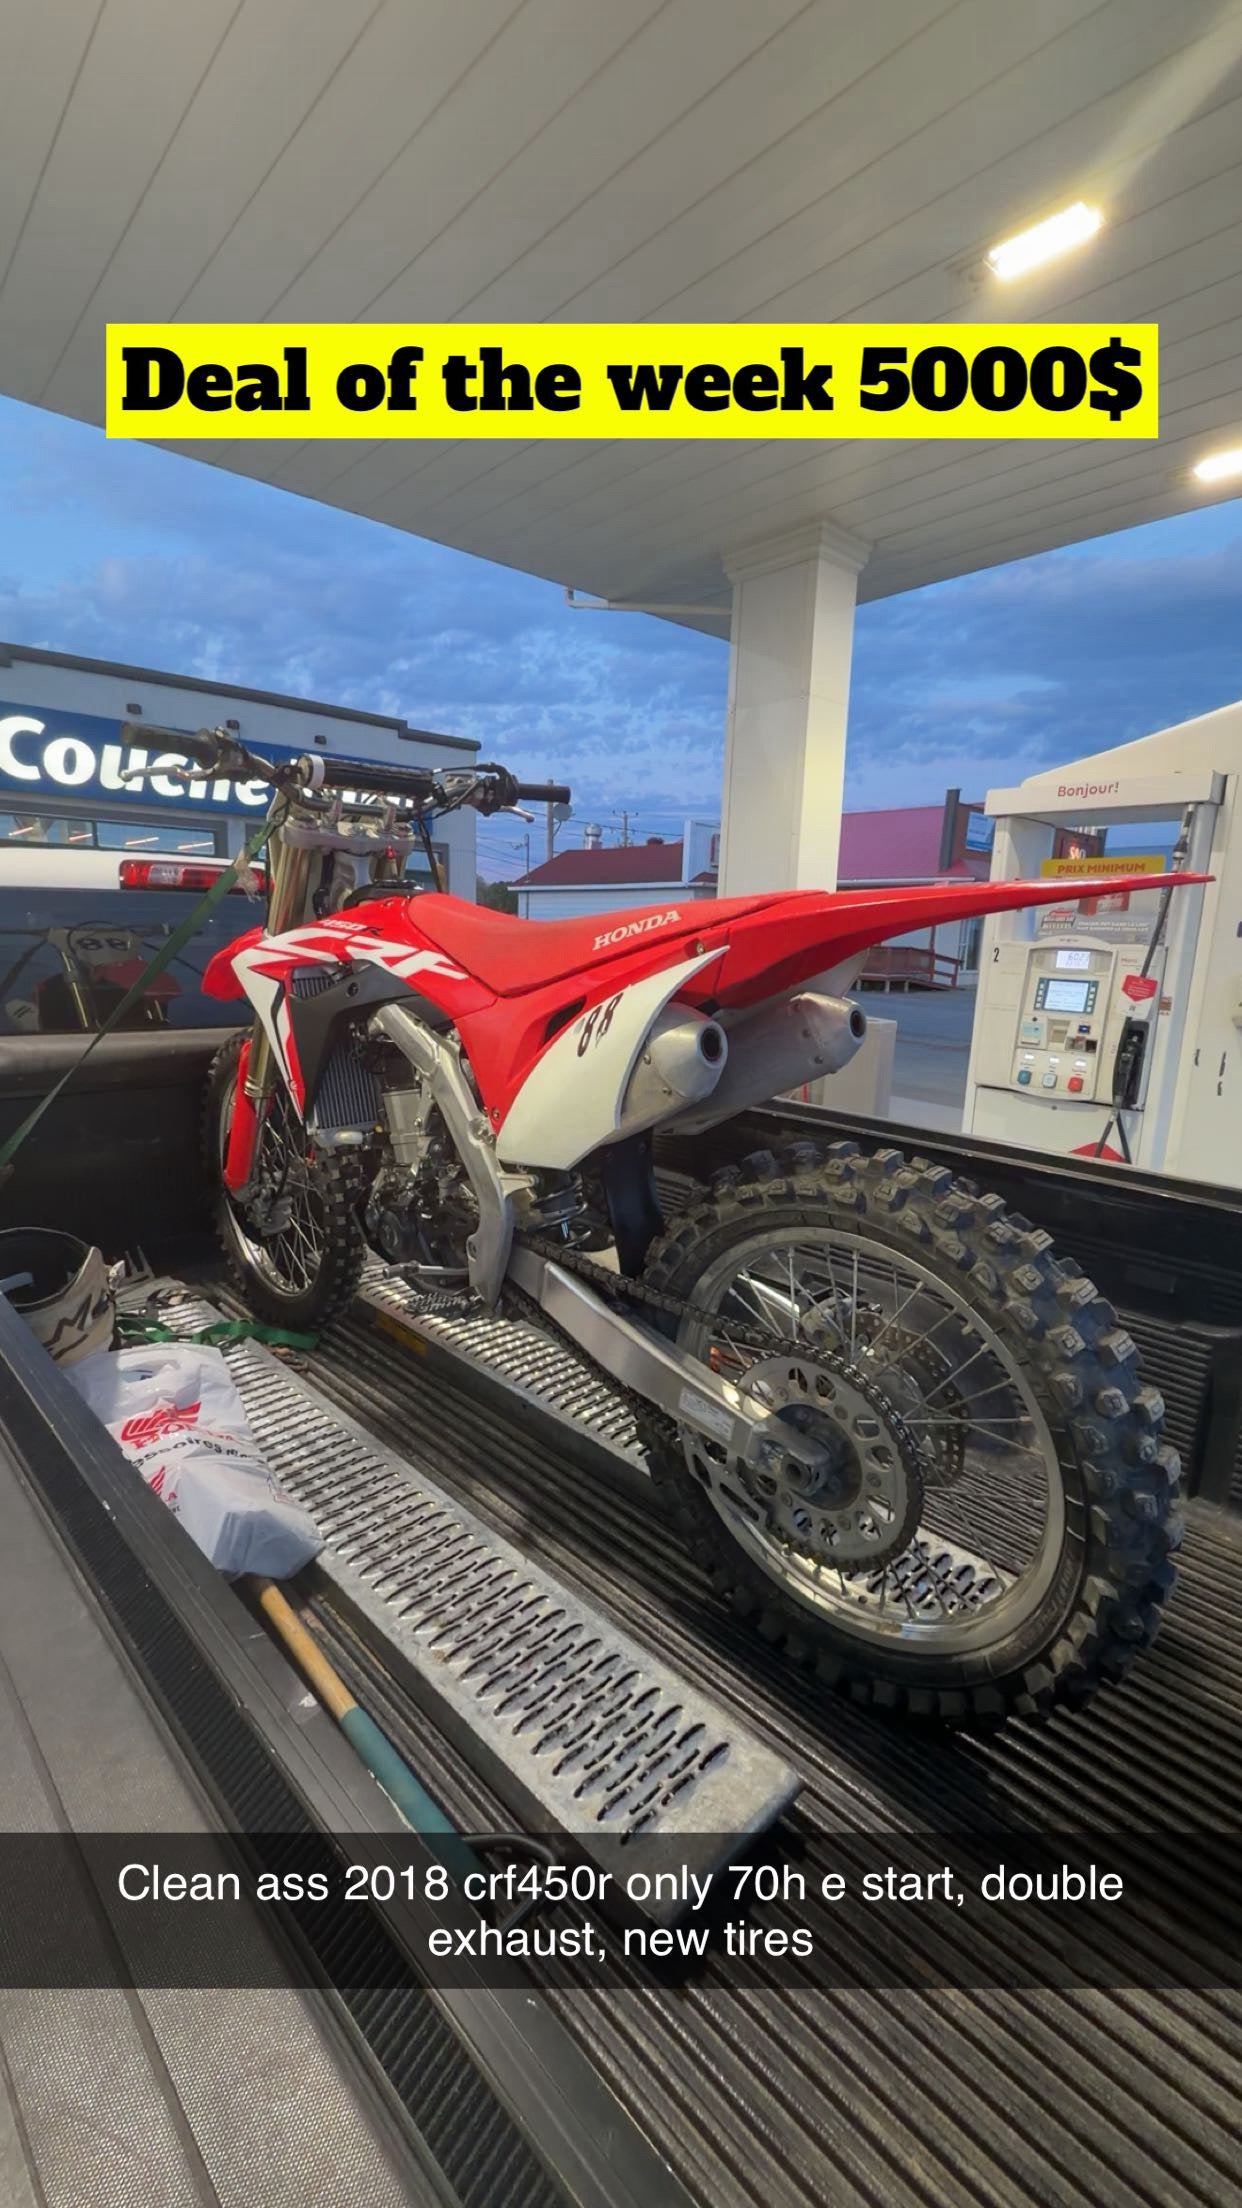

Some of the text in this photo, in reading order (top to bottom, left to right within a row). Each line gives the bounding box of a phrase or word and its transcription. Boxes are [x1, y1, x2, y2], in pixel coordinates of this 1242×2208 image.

[1058, 782, 1119, 798] Bonjour!
[1057, 862, 1145, 874] PRIX MINIMUM
[592, 910, 681, 951] HONDA
[993, 947, 1000, 963] 2
[577, 992, 624, 1057] 88
